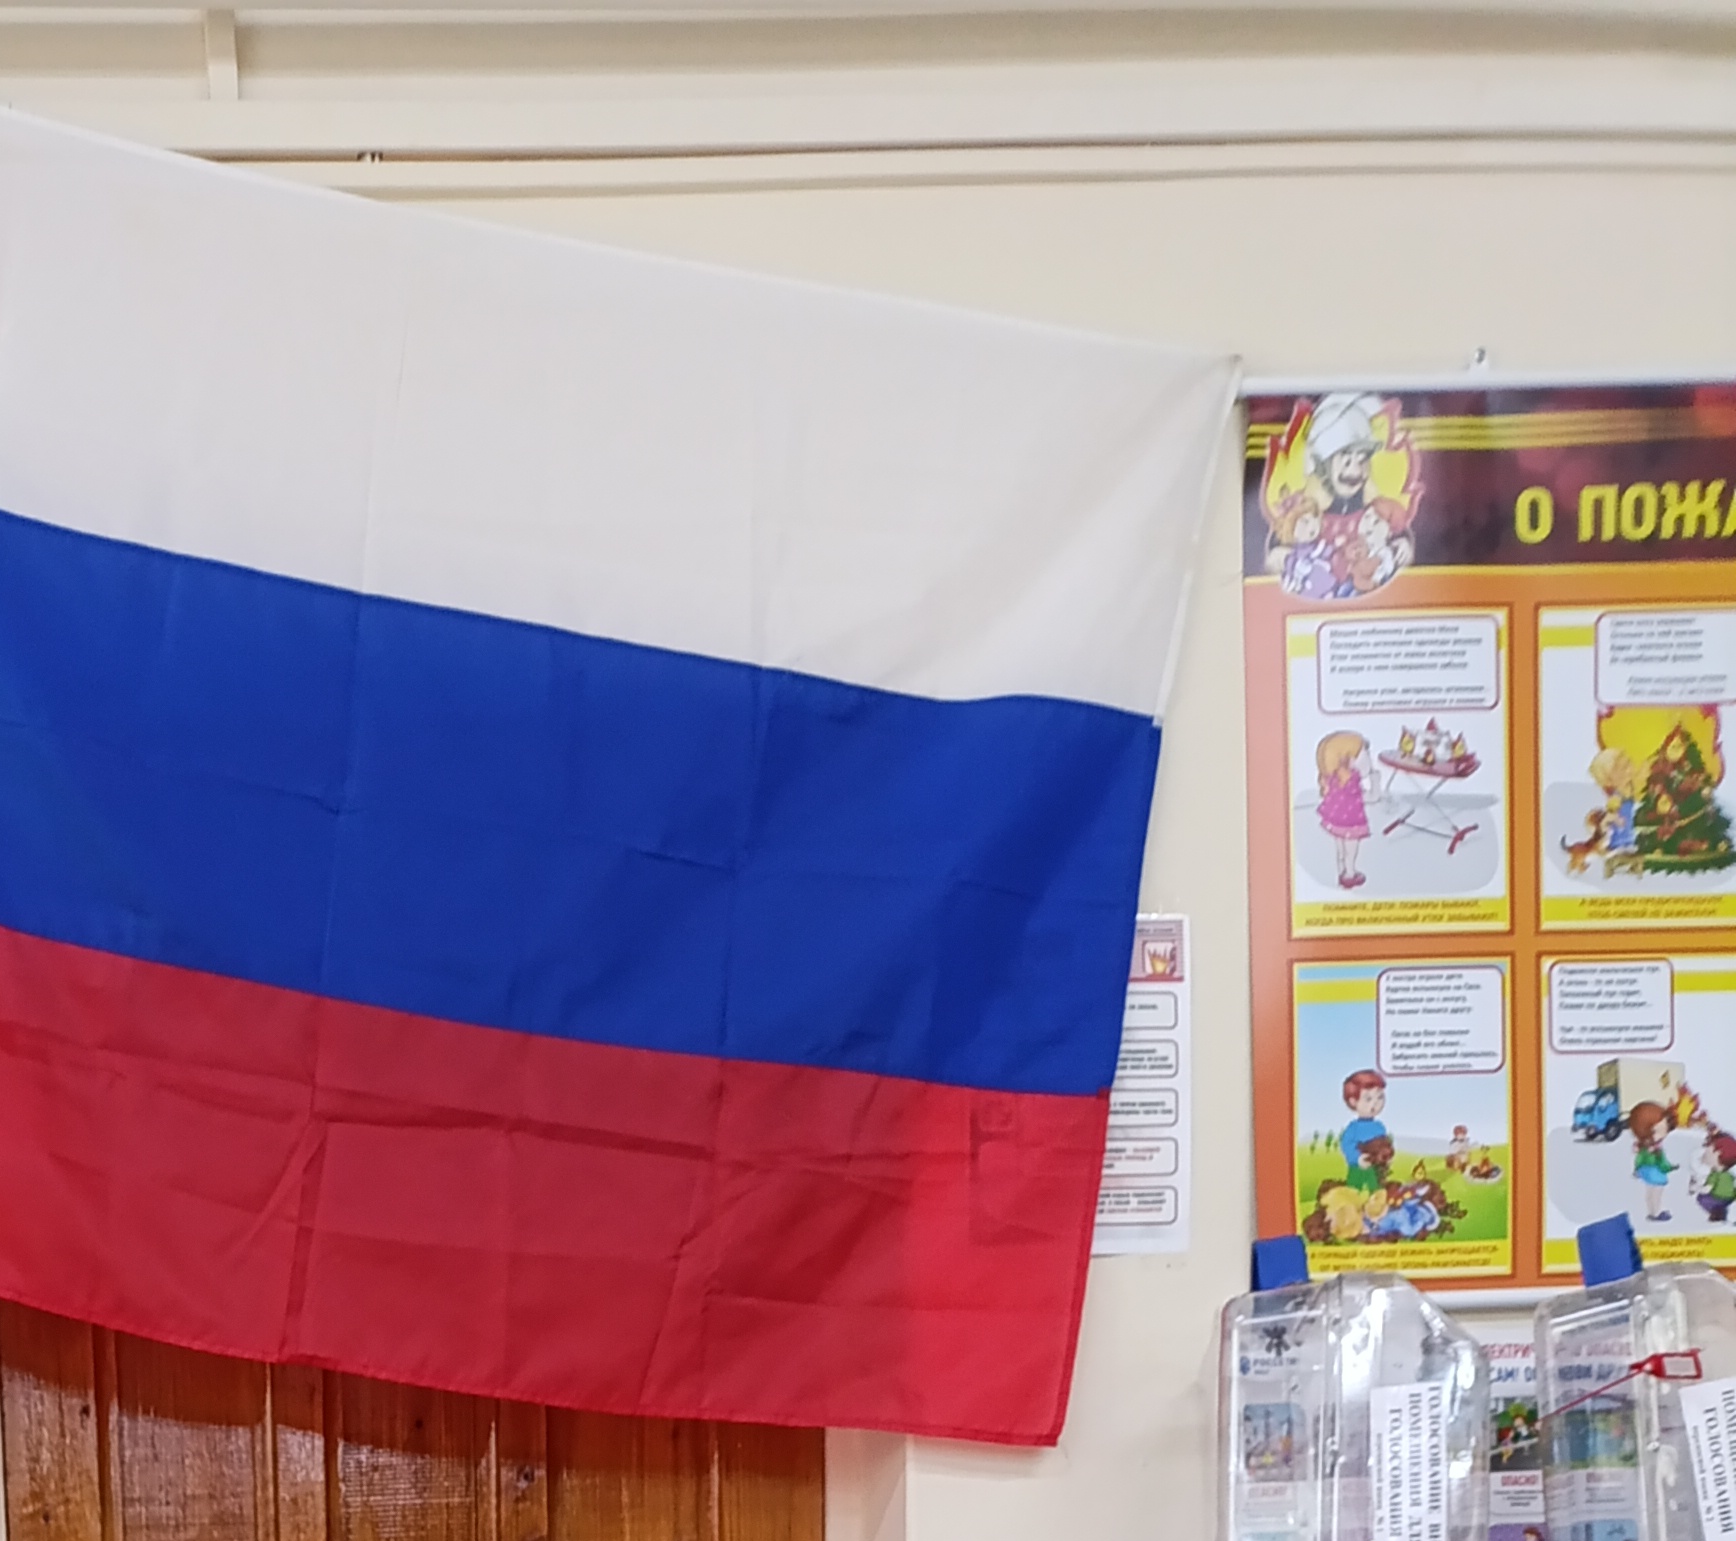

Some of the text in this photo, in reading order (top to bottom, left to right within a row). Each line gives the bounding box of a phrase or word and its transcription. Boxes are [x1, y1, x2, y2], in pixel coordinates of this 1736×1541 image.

[1515, 485, 1554, 544] О
[1389, 1408, 1403, 1538] ГОЛОСОВАНИЯ
[1408, 1392, 1422, 1508] ПОМЕЩЕНИЯ
[1427, 1386, 1442, 1515] ГОЛОСОВАНИЕ
[1703, 1406, 1735, 1534] ГОЛОСОВАНИЯ
